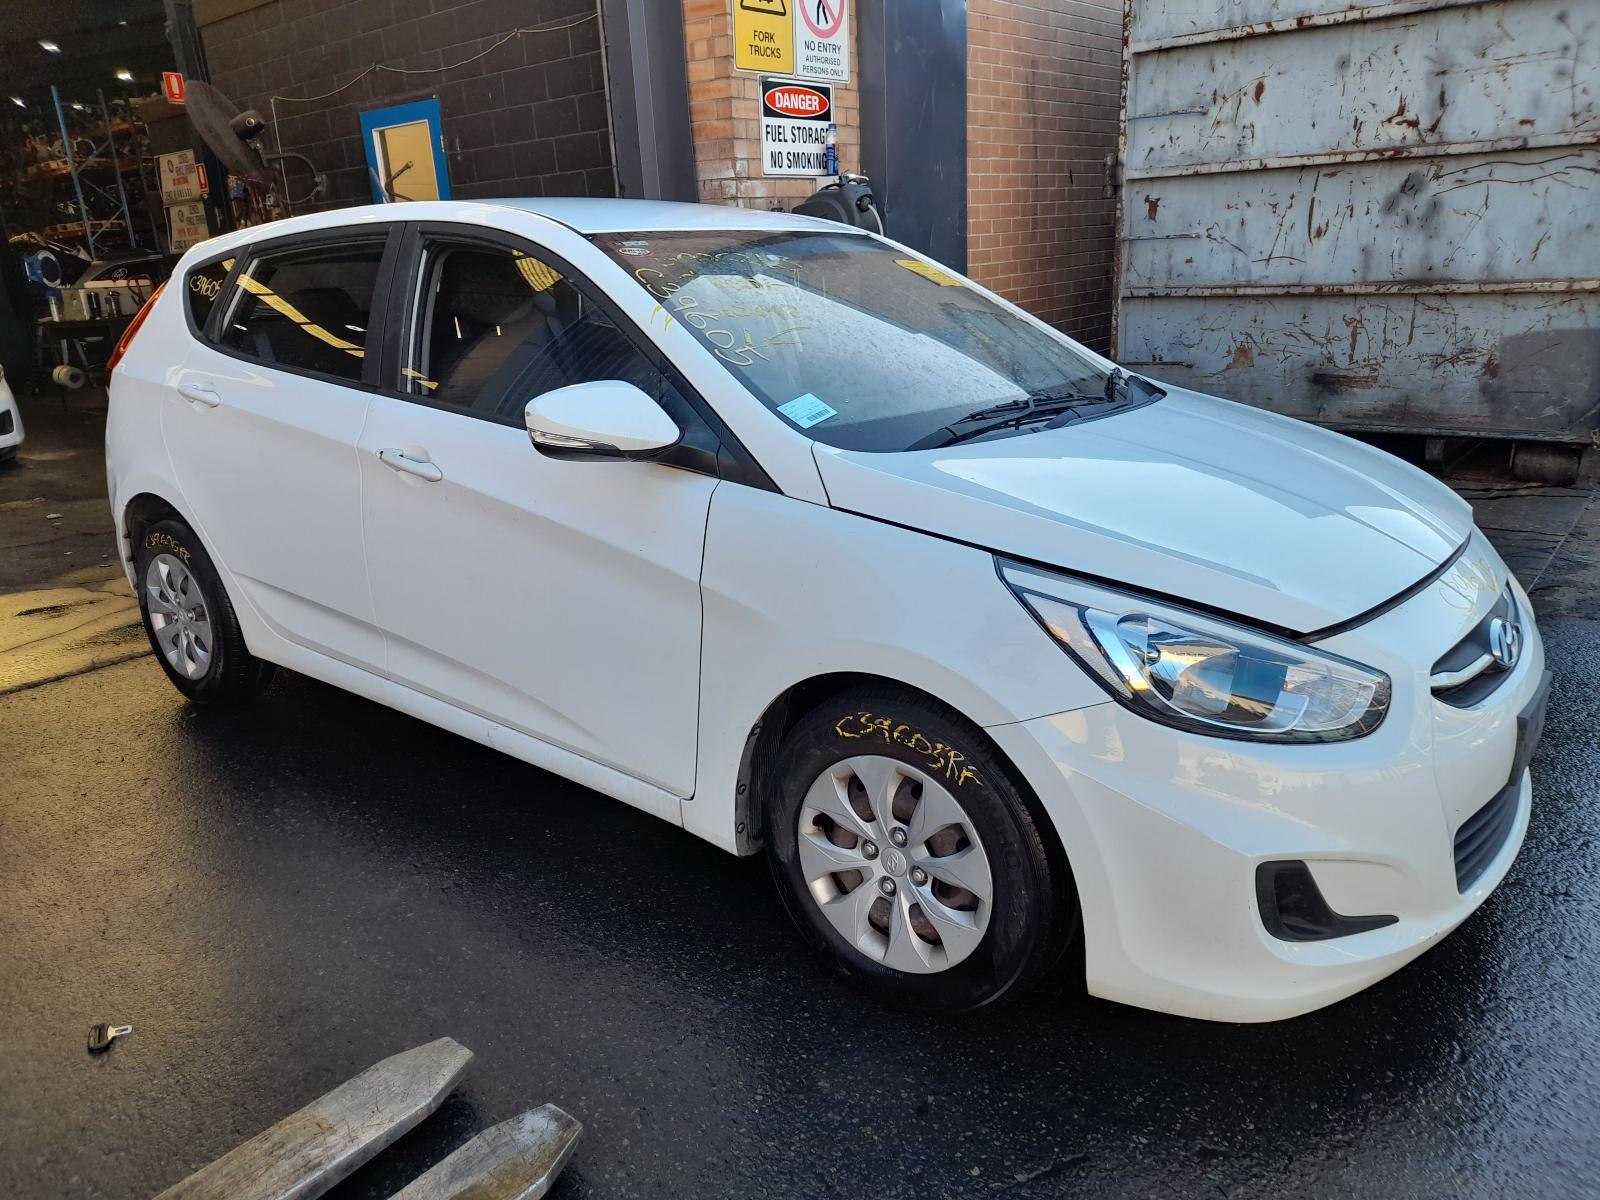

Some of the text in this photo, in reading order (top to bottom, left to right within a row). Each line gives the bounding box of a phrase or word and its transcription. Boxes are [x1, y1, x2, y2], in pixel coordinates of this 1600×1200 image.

[753, 30, 776, 43] FORK
[749, 44, 781, 59] TRUCKS
[804, 40, 842, 54] NO ENTRY
[805, 56, 841, 66] AUTHORISED
[802, 65, 844, 77] PERSONS ONLY
[775, 92, 820, 111] DANGER
[765, 125, 829, 145] FUEL STORAG
[770, 151, 828, 170] NO SMOKING
